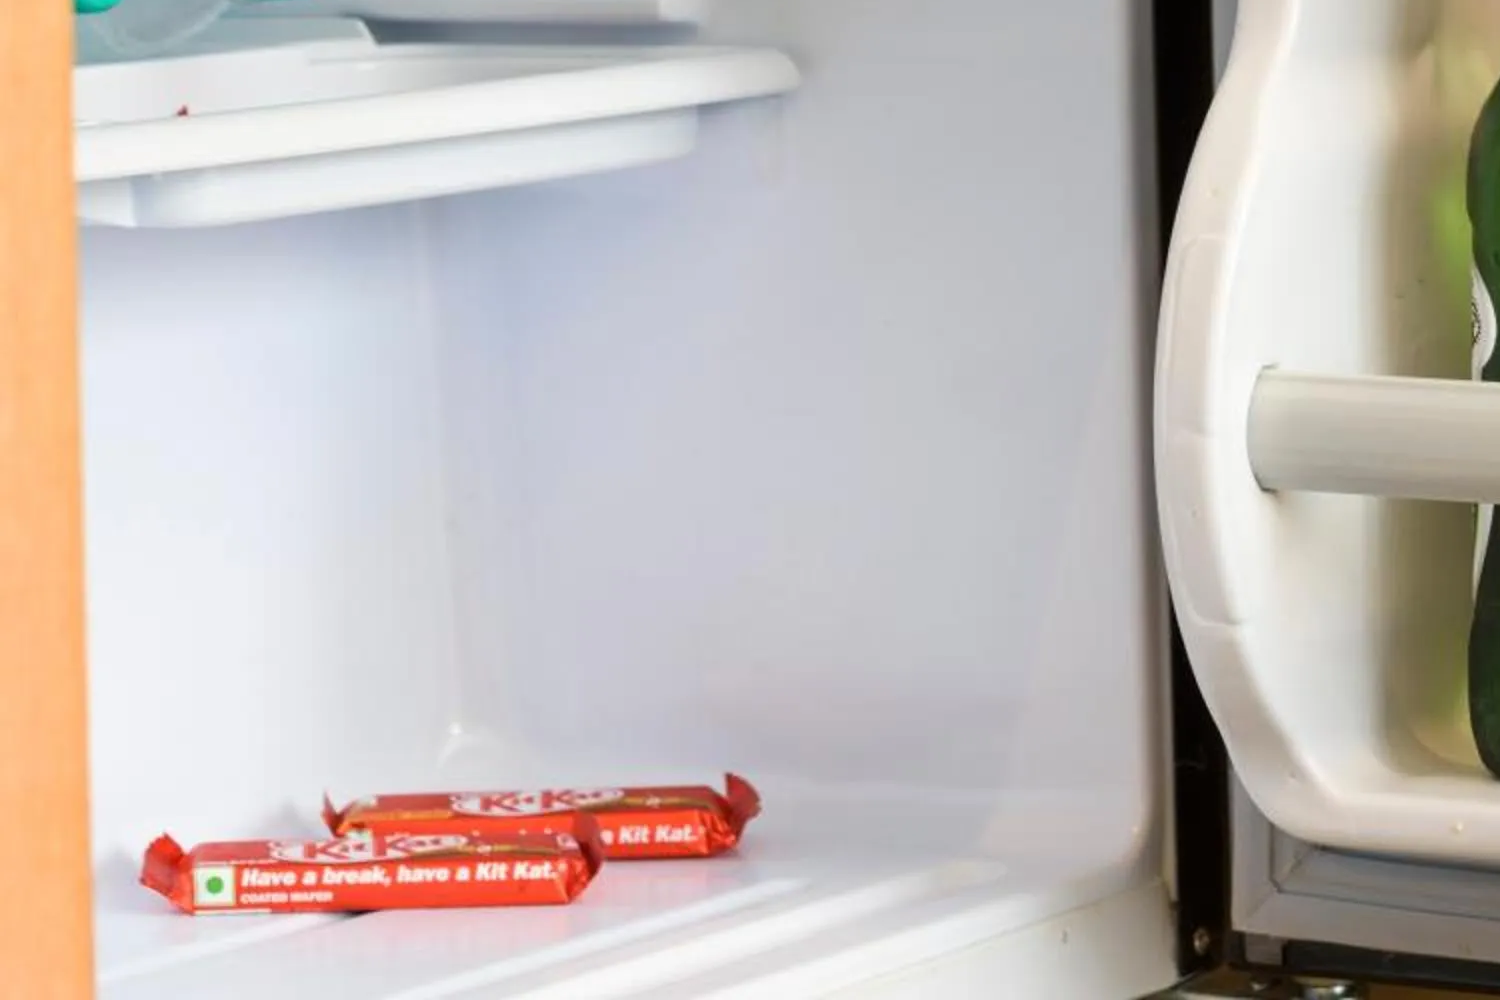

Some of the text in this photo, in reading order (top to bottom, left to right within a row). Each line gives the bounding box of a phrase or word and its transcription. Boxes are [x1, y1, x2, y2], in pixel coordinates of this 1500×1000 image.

[618, 825, 651, 845] Kit
[241, 868, 296, 887] Have
[302, 870, 318, 886] a
[322, 866, 392, 887] break,
[395, 864, 449, 883] have
[455, 866, 471, 882] a
[475, 861, 510, 881] Kit
